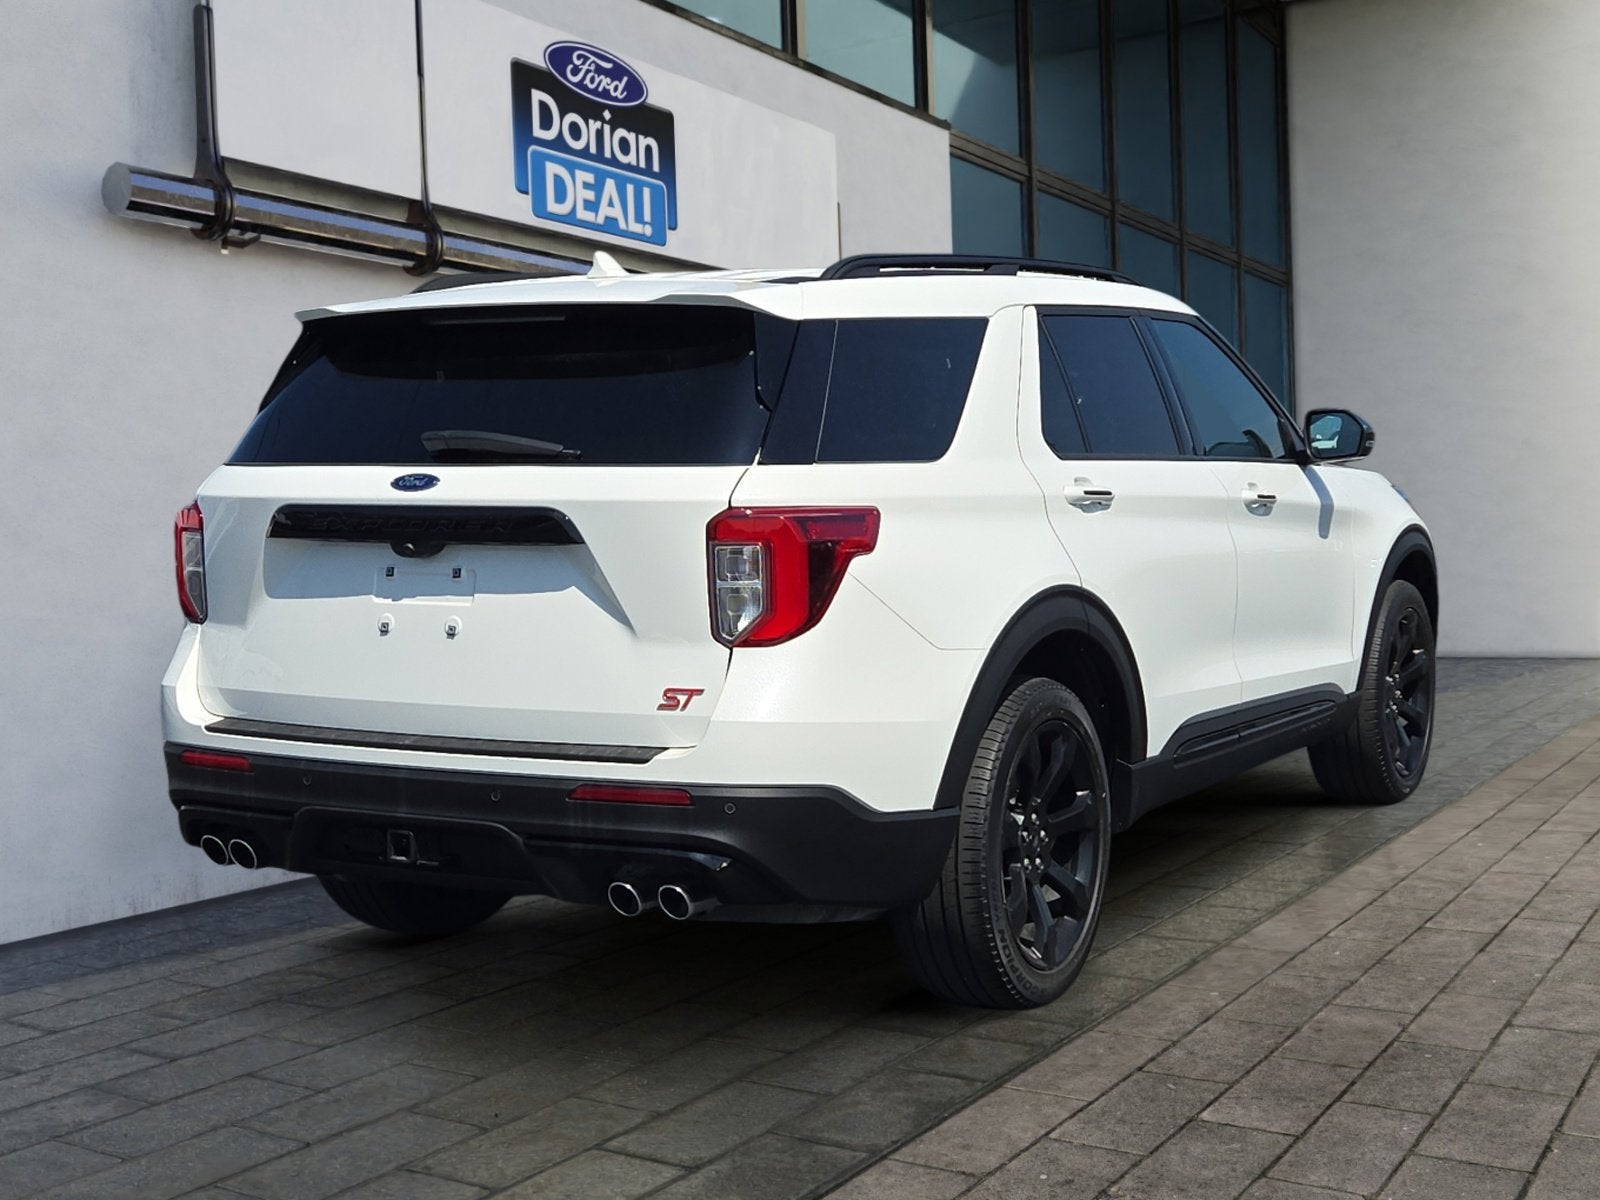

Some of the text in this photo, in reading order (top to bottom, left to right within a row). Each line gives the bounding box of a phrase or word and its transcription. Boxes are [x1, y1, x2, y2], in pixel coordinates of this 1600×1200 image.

[566, 50, 627, 99] Ford
[531, 88, 660, 173] Dorian
[545, 161, 653, 237] DEAL!
[656, 687, 705, 712] ST
